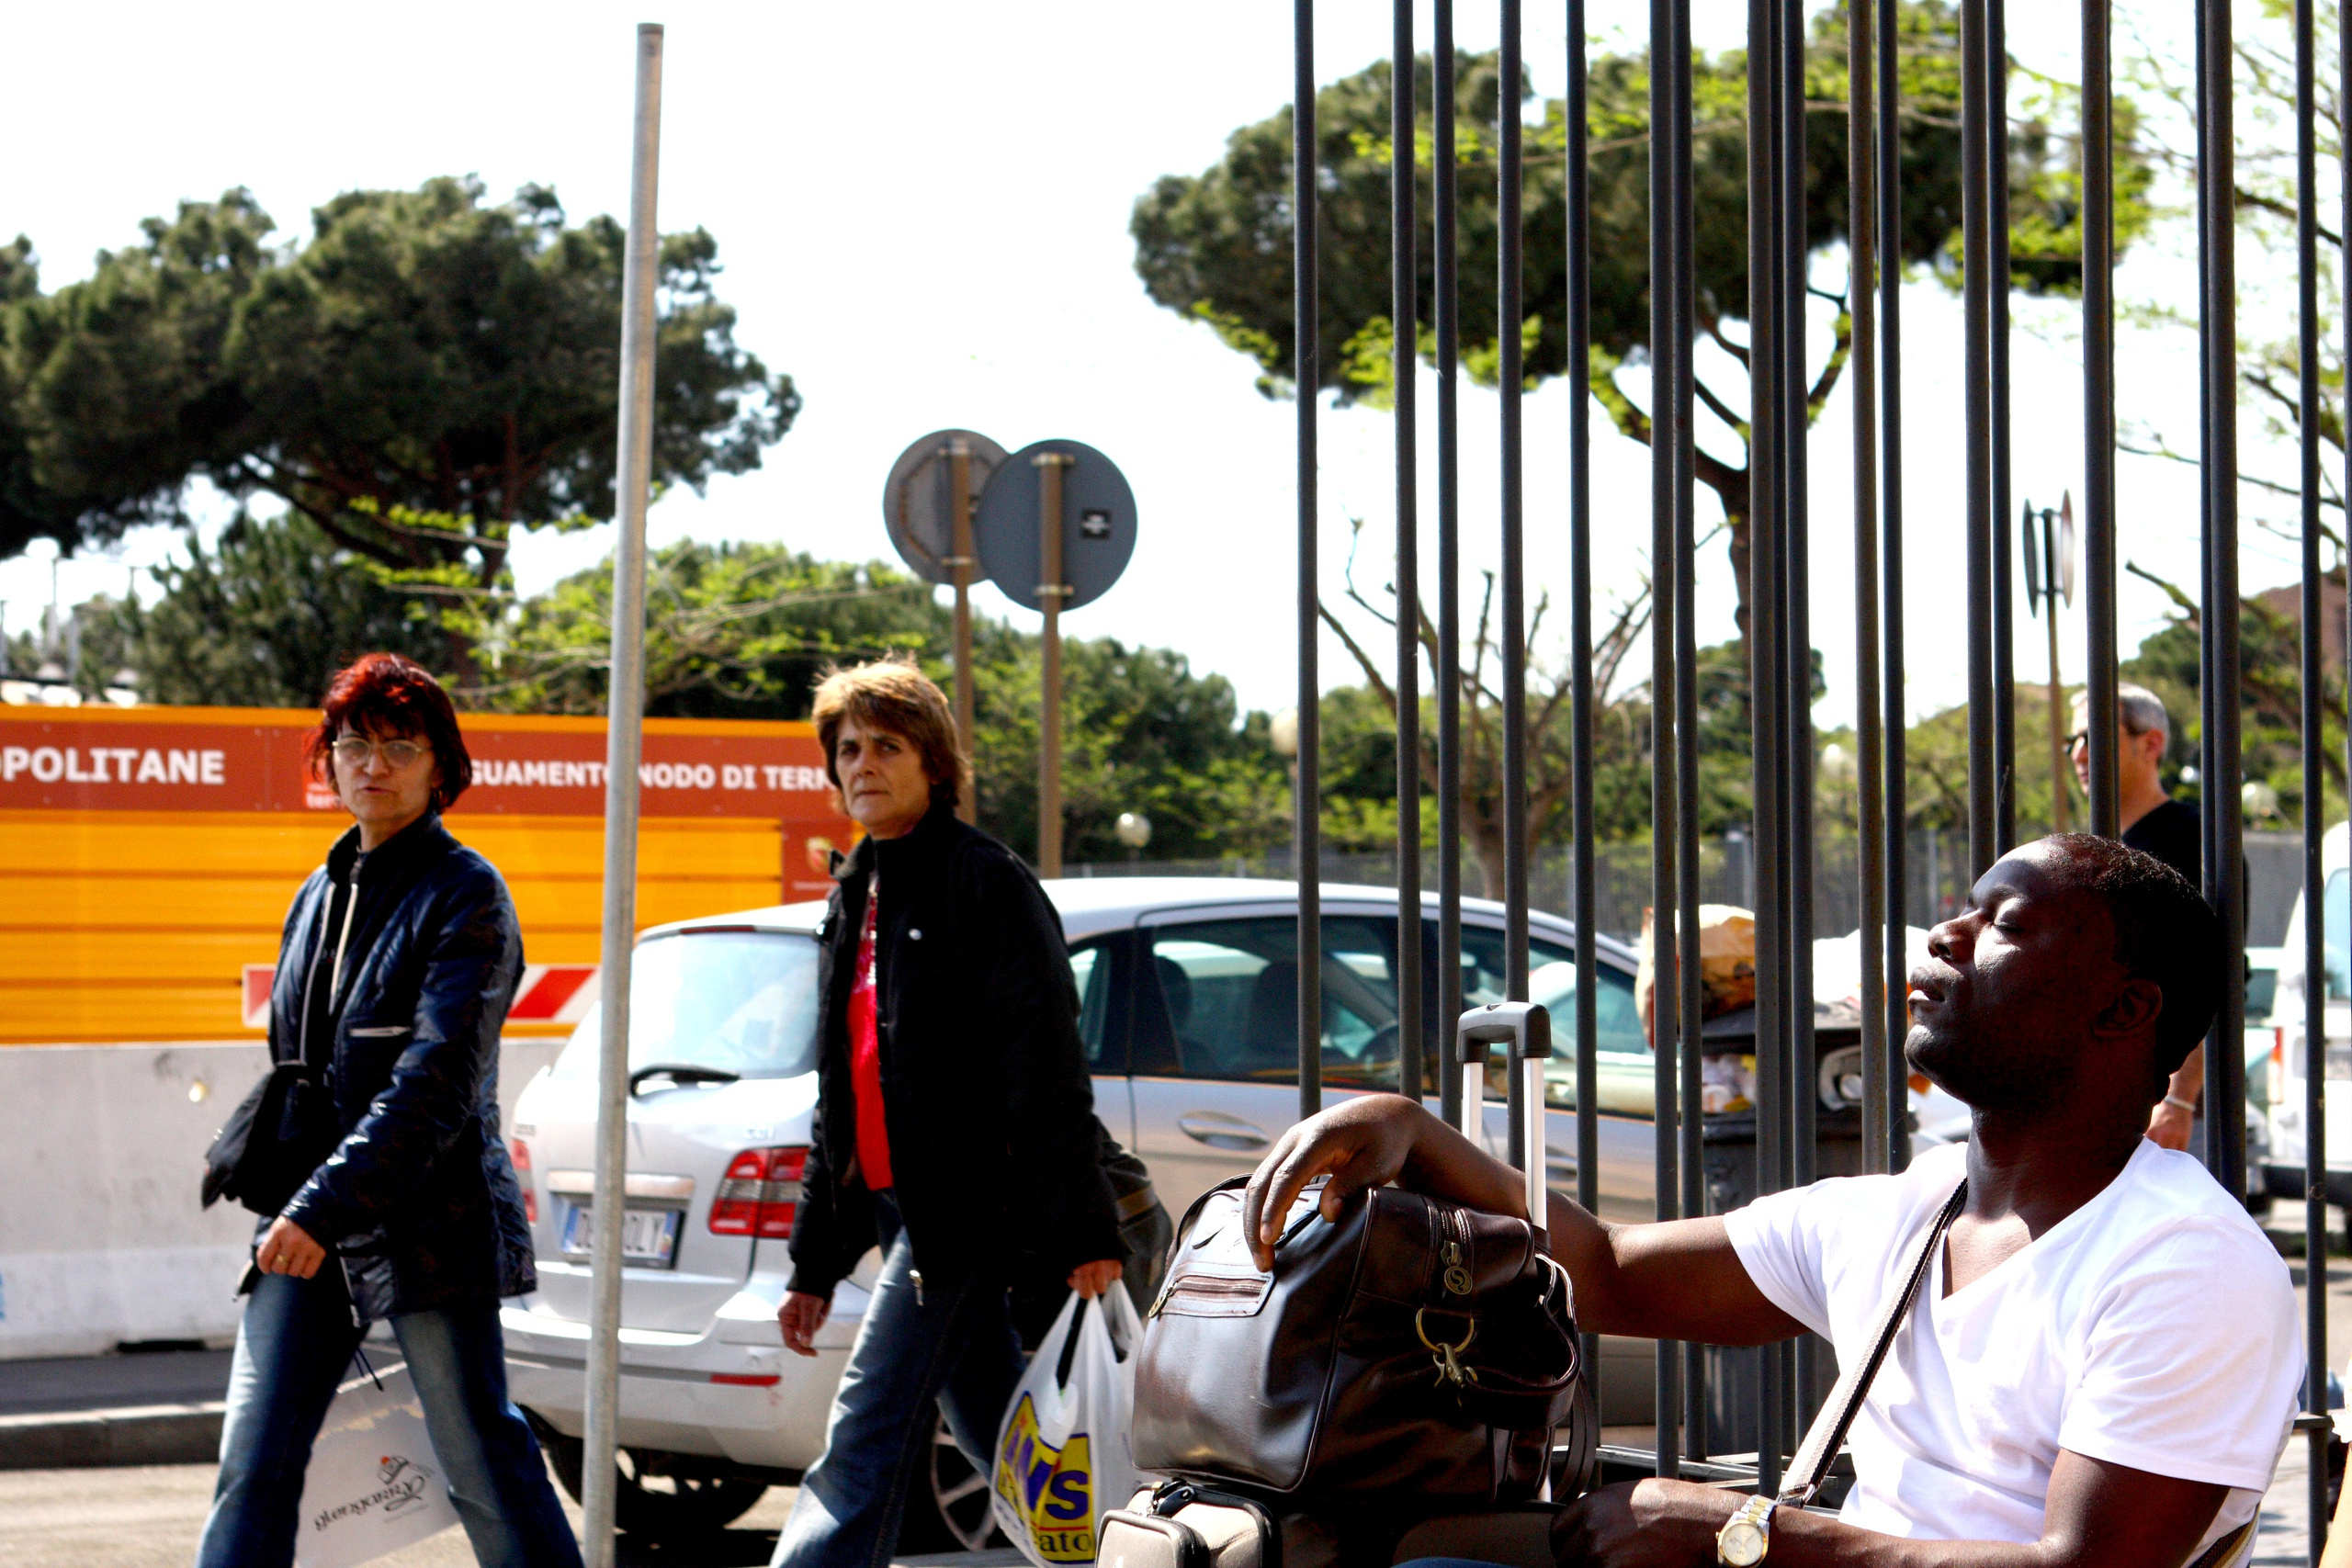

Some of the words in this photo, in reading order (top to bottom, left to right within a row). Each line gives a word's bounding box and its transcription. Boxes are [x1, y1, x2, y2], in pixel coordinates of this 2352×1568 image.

[0, 746, 225, 784] POLITANE
[639, 762, 717, 789] NODO
[722, 765, 758, 791] DI
